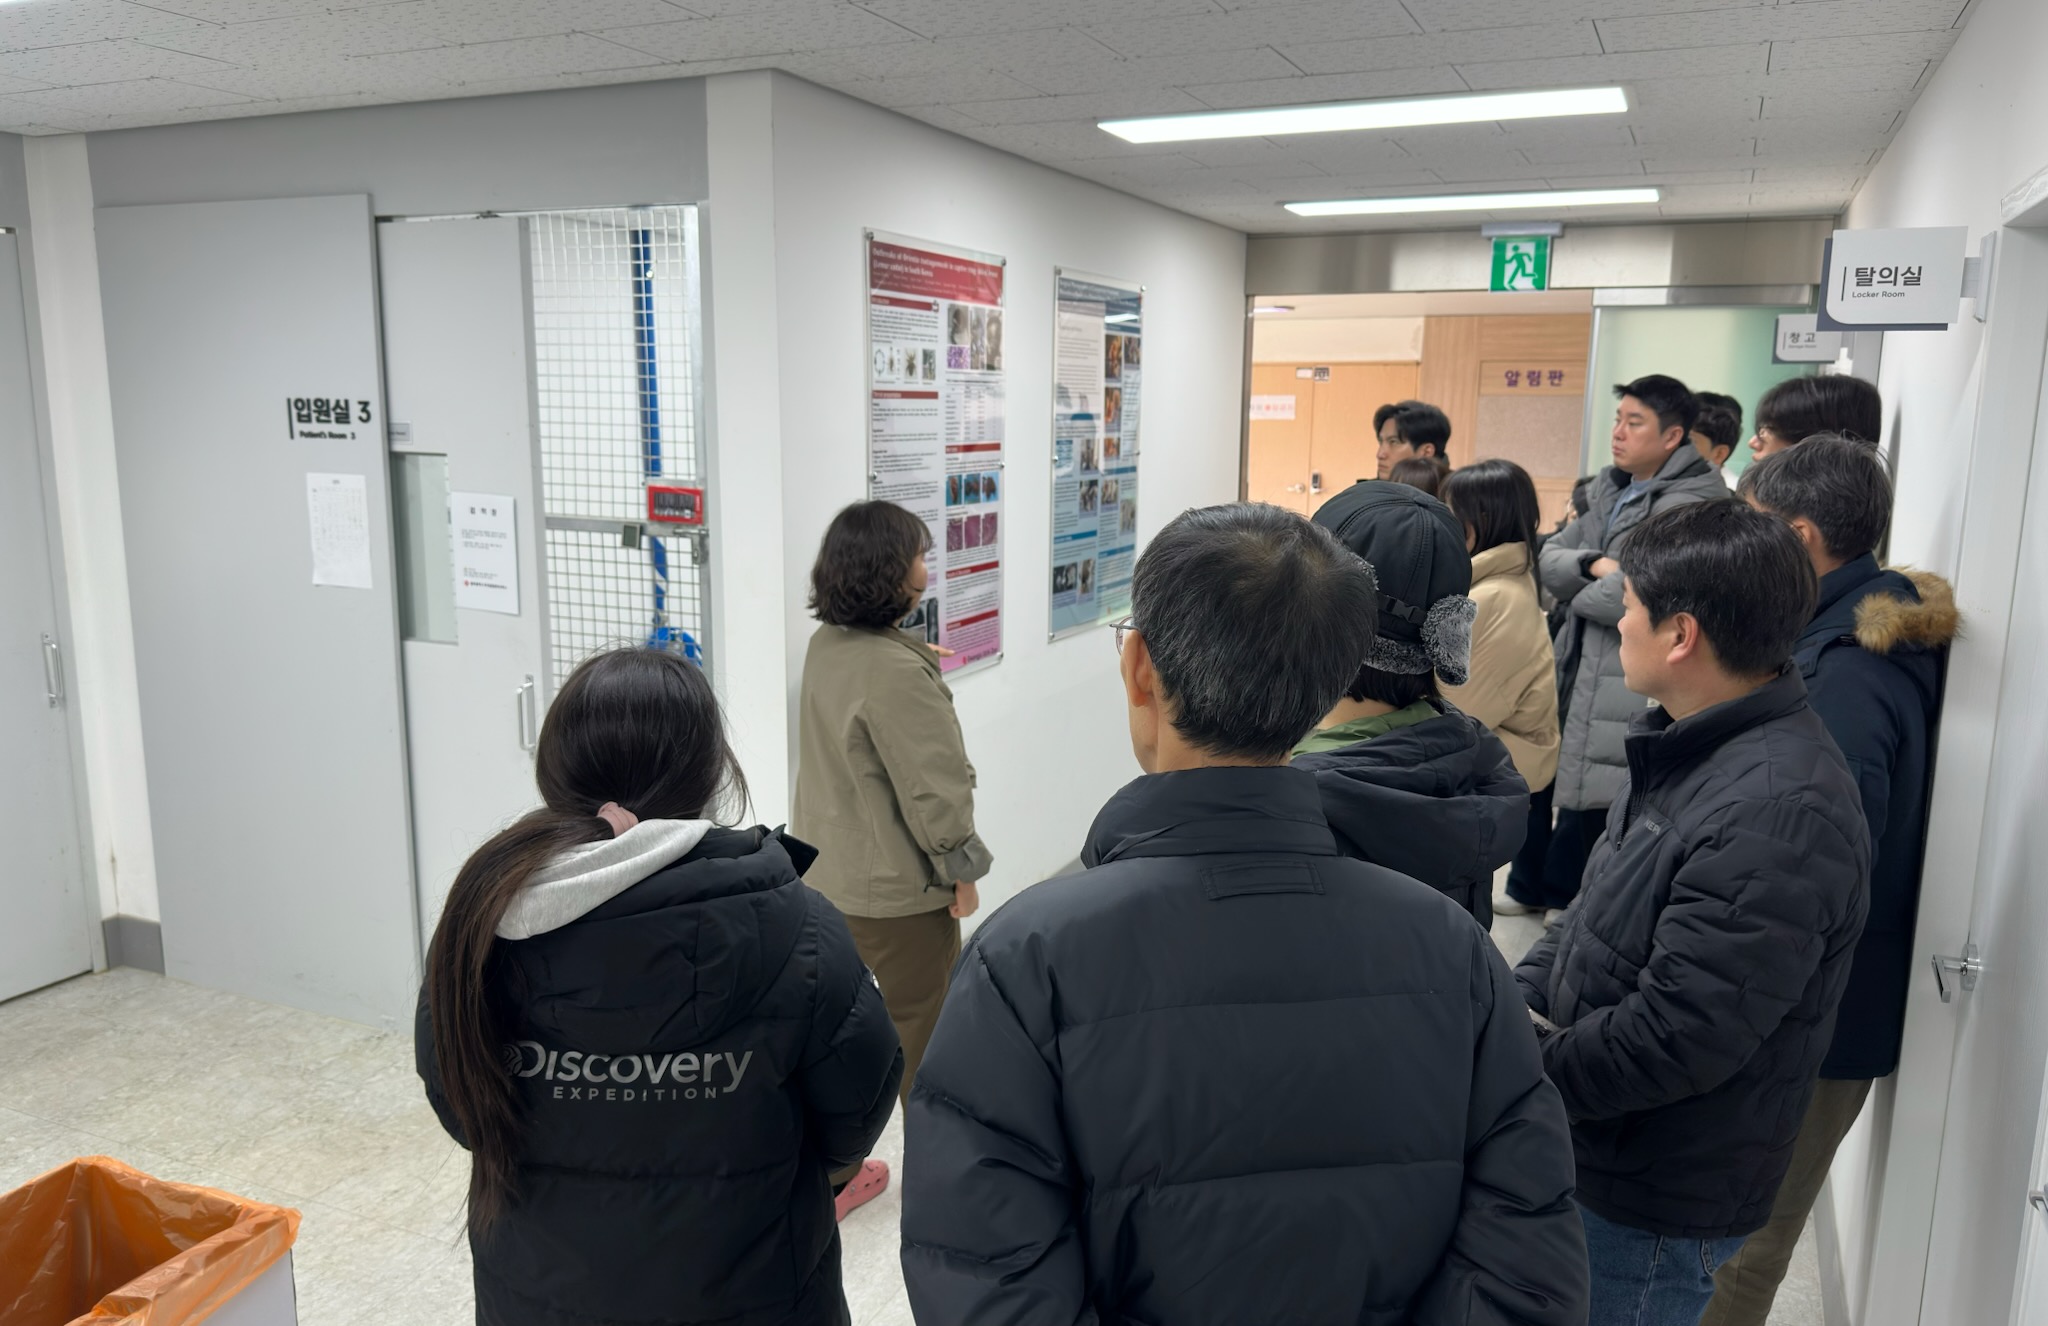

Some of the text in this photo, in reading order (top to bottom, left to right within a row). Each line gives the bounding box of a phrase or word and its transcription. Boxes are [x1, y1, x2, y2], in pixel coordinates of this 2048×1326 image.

[1855, 266, 1923, 287] 탈의실
[1852, 290, 1905, 298] Locker Room
[293, 398, 372, 424] 입원실 3
[299, 430, 327, 439] Patient's
[328, 431, 348, 440] Room
[553, 1086, 718, 1102] EXPEDITION
